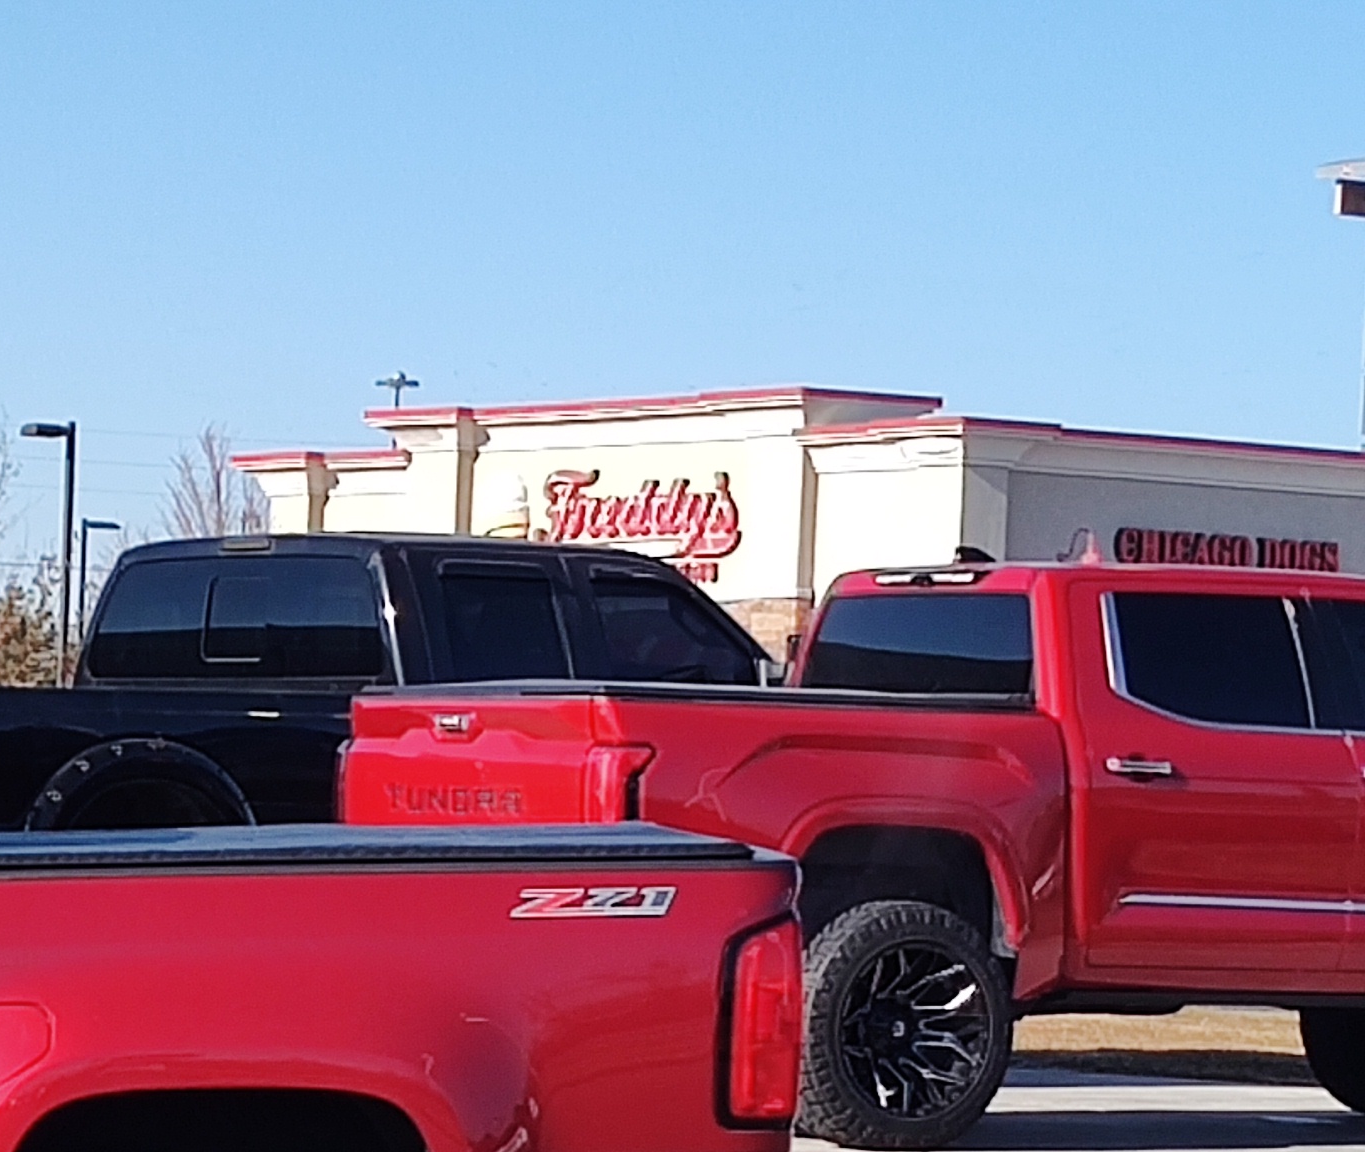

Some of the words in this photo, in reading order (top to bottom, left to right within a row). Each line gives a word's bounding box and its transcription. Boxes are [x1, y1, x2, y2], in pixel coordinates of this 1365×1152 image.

[534, 469, 742, 558] Freddy's
[1114, 527, 1254, 567] CHICAGO
[1256, 537, 1339, 573] DOGS
[383, 783, 526, 816] TUNDRA
[510, 886, 677, 918] Z71
